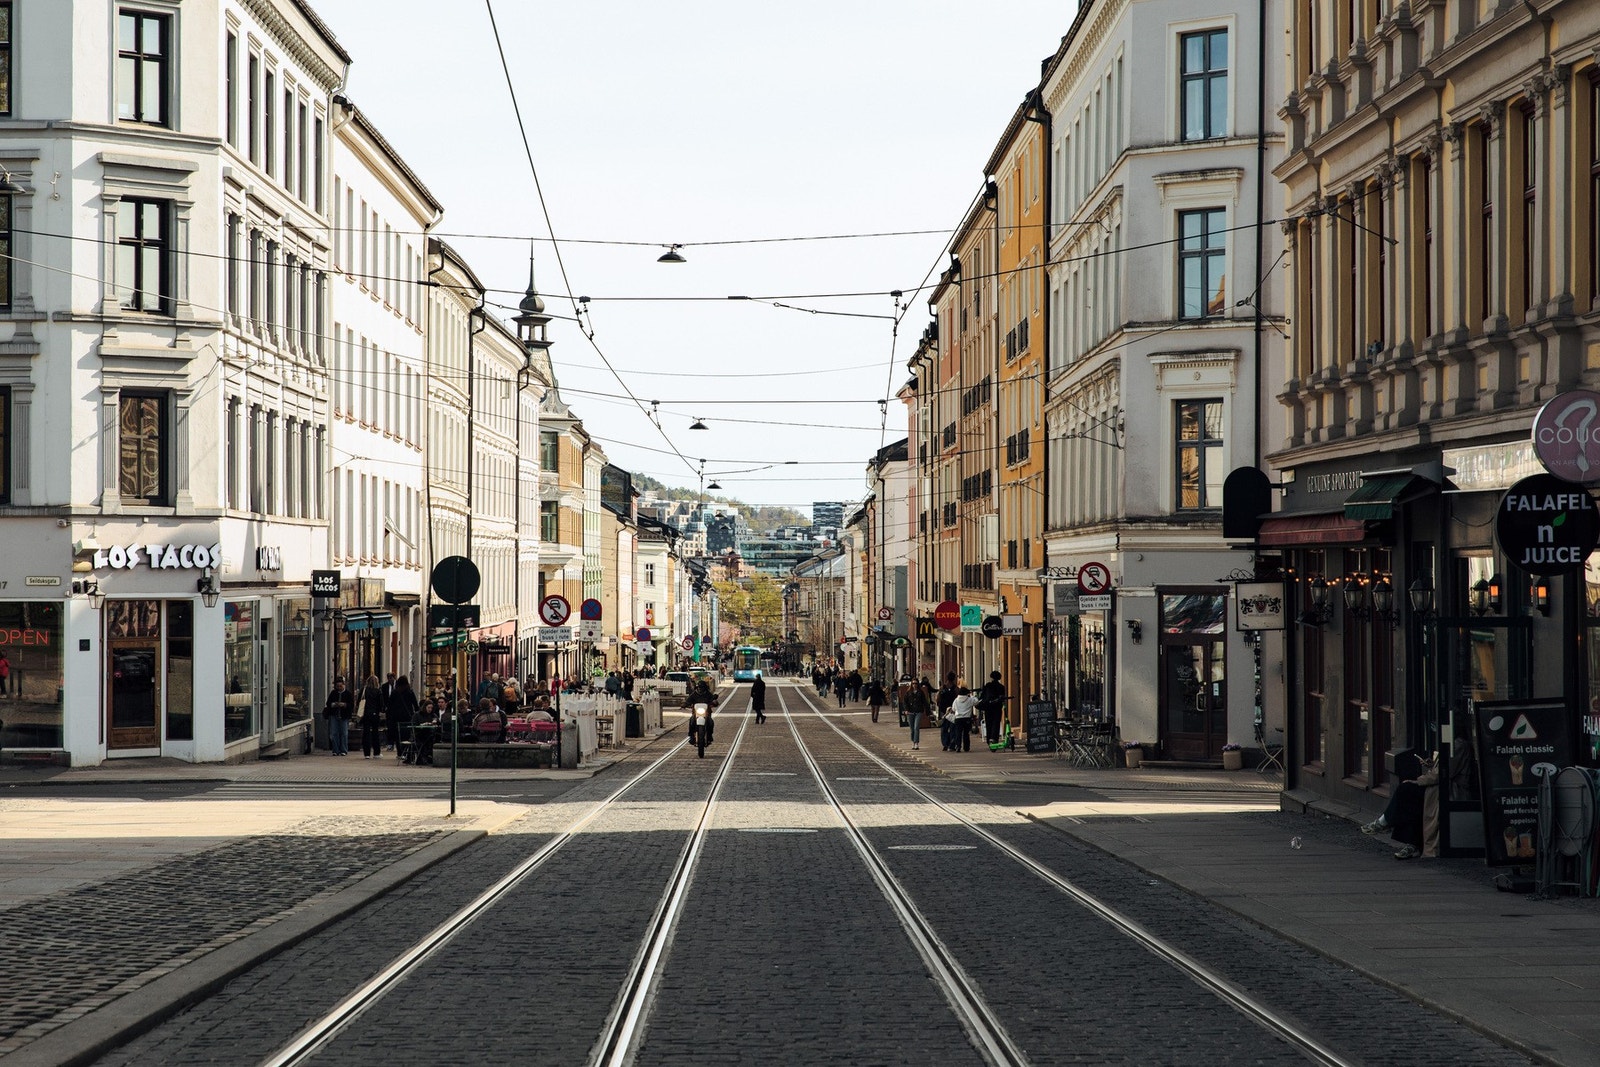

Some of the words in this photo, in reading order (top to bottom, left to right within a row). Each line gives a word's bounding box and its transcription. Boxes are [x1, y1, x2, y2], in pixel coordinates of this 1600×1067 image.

[1506, 493, 1592, 512] FALAFEL
[1537, 523, 1554, 543] n
[93, 542, 142, 570] LOS
[144, 542, 222, 570] TACOS
[1520, 546, 1582, 565] JUICE
[313, 584, 339, 592] TACOS
[319, 576, 334, 584] LOS
[0, 629, 49, 645] OPEN
[1583, 715, 1600, 736] FALA
[1496, 744, 1524, 754] Falafel
[1525, 744, 1554, 753] classic
[1501, 795, 1529, 805] Falafel
